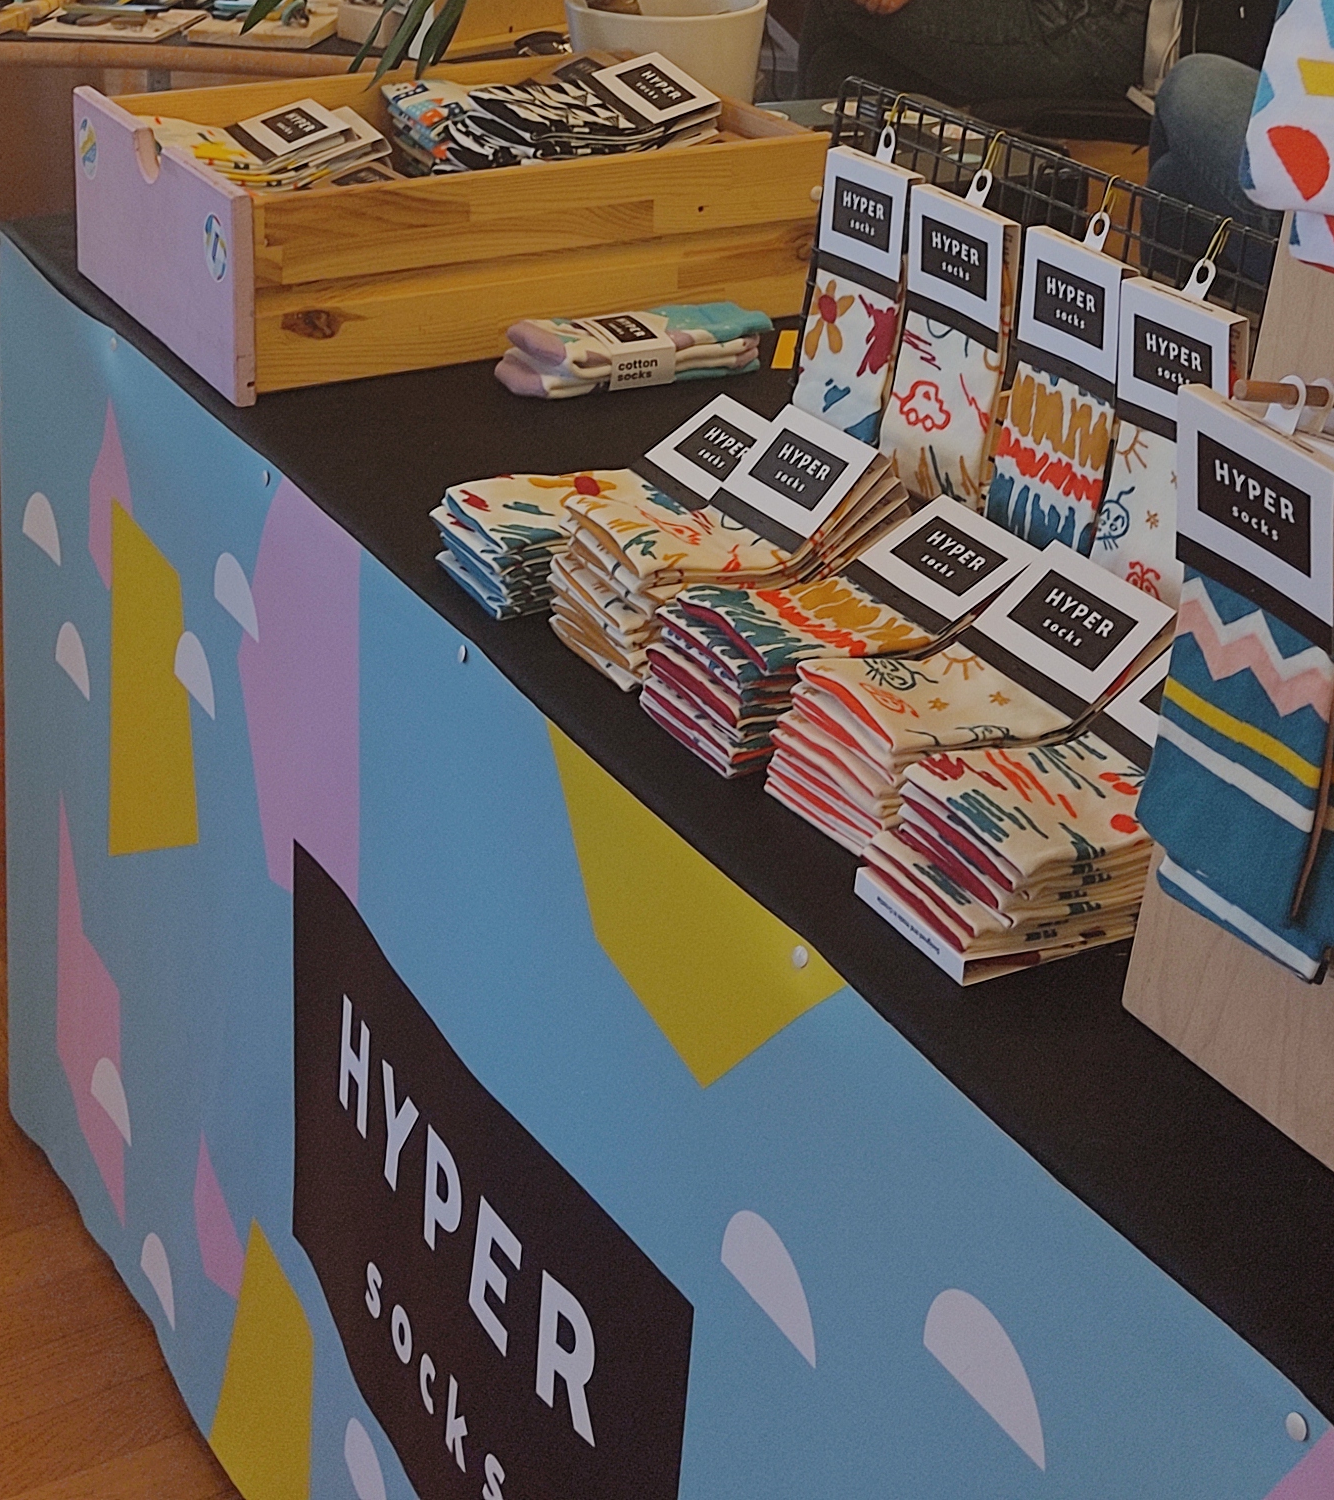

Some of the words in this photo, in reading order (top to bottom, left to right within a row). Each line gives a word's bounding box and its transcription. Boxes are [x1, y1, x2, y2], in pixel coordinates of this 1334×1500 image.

[640, 70, 683, 100] HYPER
[842, 190, 885, 220] HYPER
[850, 219, 875, 236] socks
[931, 231, 980, 266] HYPER
[941, 261, 970, 281] socks
[1046, 276, 1096, 313] HYPER
[1055, 309, 1086, 330] socks
[618, 357, 658, 371] cotton
[1145, 332, 1202, 372] HYPER
[617, 371, 652, 382] socks
[697, 448, 726, 469] socks
[777, 442, 831, 481] HYPER
[774, 470, 806, 493] socks
[1214, 459, 1296, 524] HYPER
[1231, 505, 1280, 542] socks
[920, 553, 956, 579] socks
[925, 530, 988, 573] HYPER
[1044, 587, 1115, 638] HYPER
[1042, 617, 1083, 648] socks
[338, 993, 597, 1448] HYPER
[364, 1260, 507, 1500] socks
